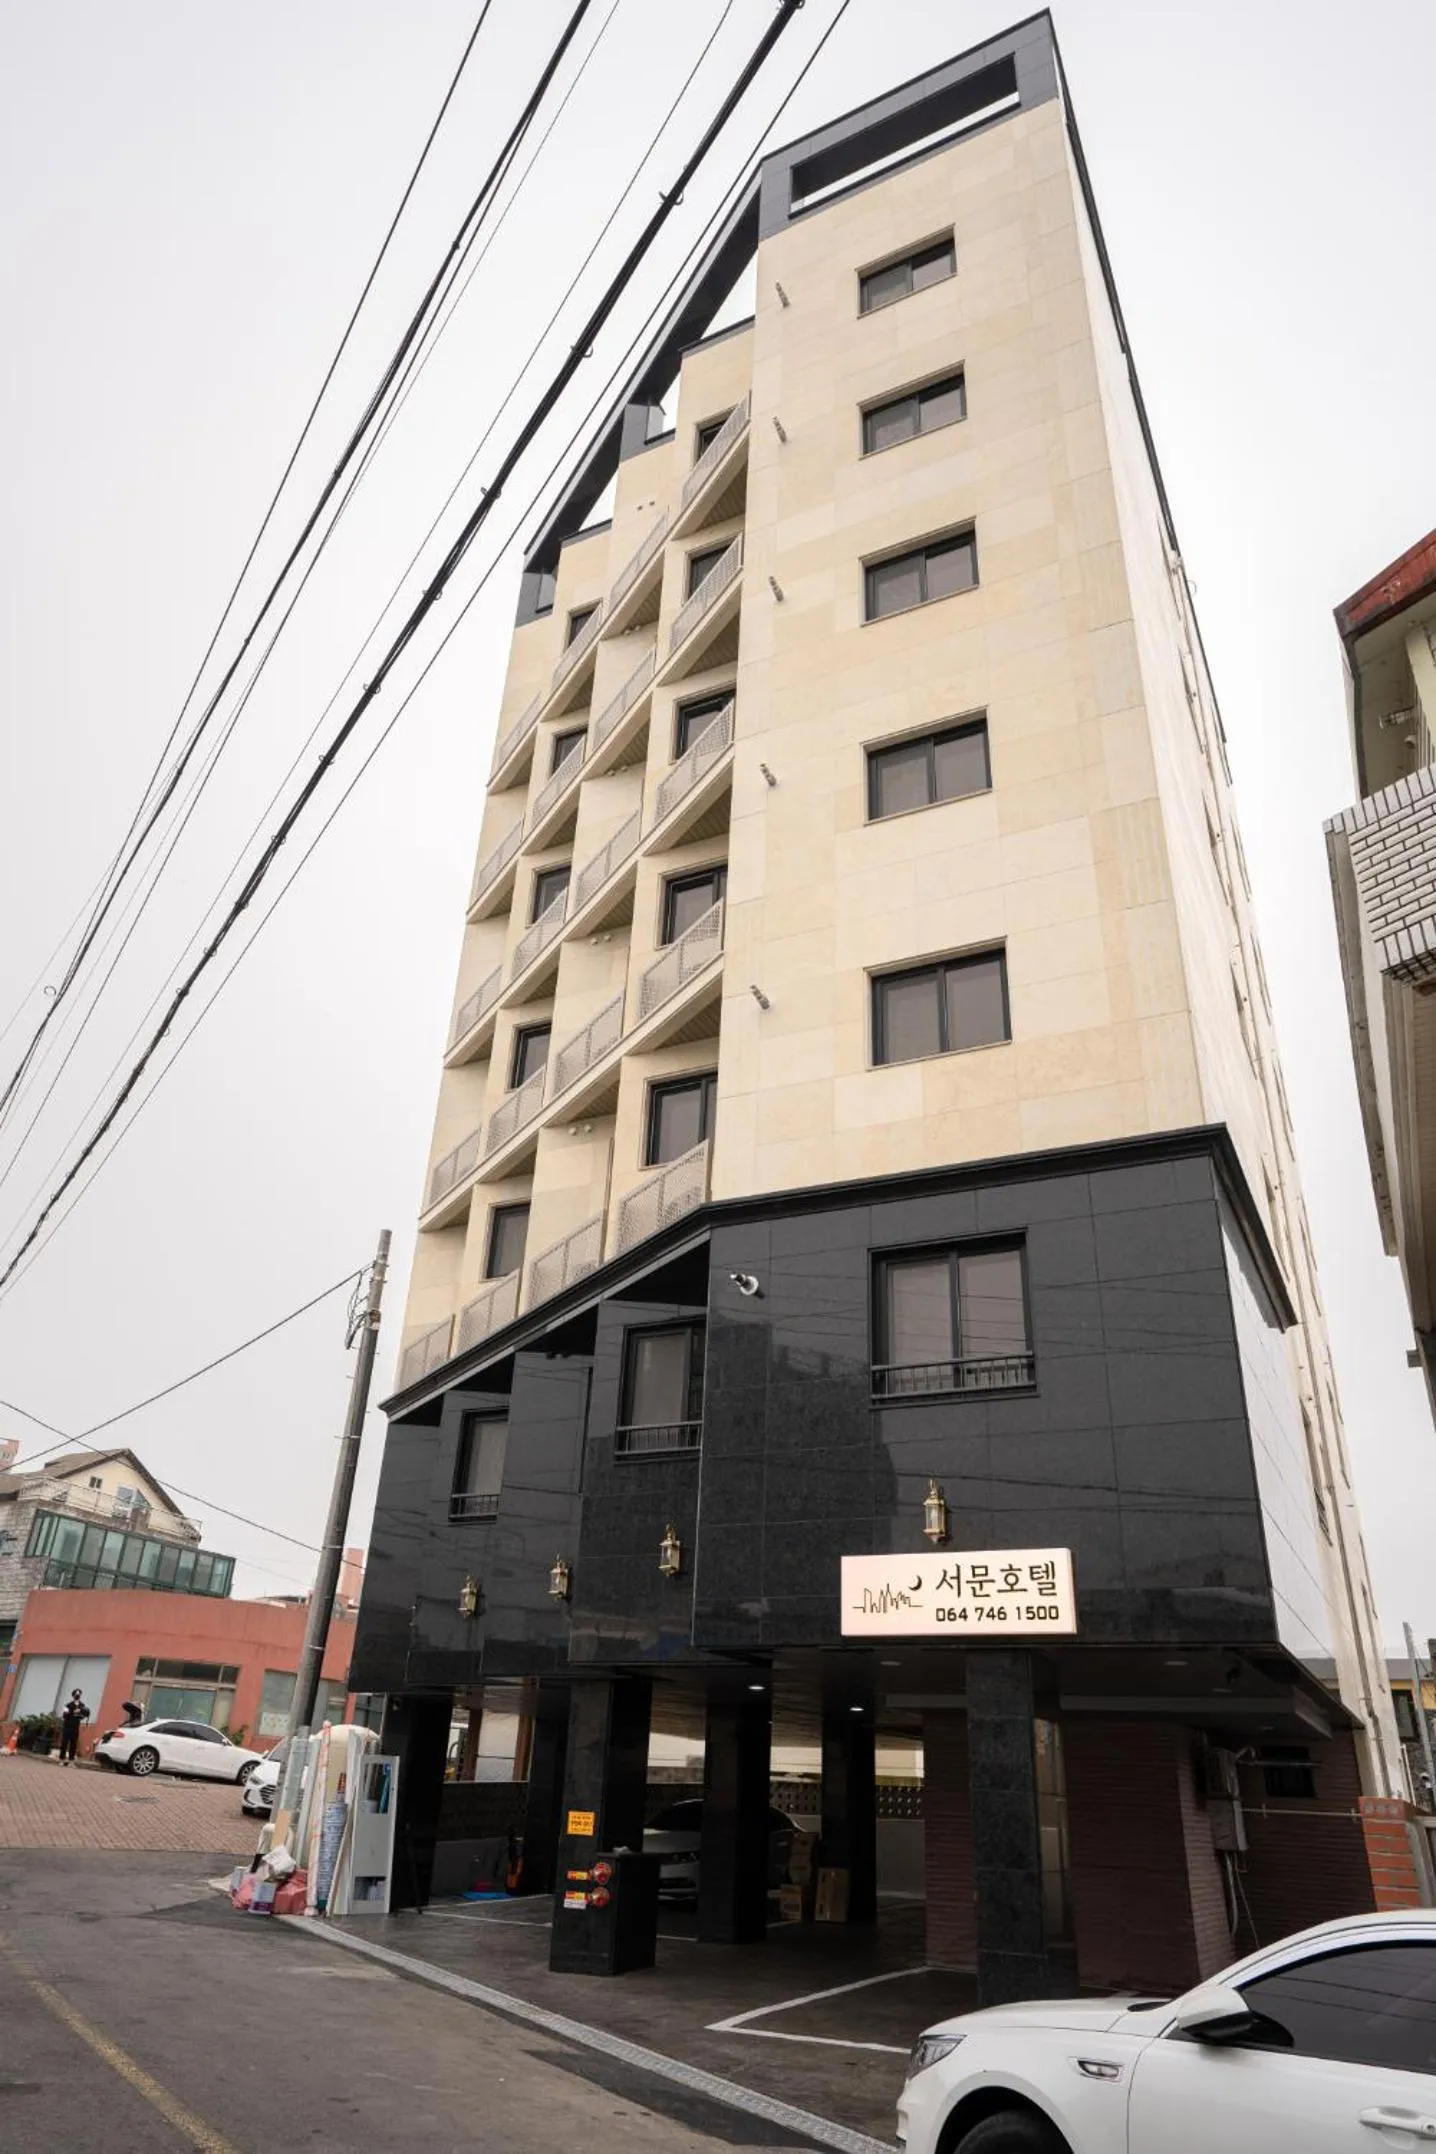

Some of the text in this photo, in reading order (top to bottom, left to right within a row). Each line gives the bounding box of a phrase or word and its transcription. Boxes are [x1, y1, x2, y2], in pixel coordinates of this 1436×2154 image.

[935, 1560, 1058, 1598] 서문호텔
[935, 1605, 1060, 1622] 064 746 1500
